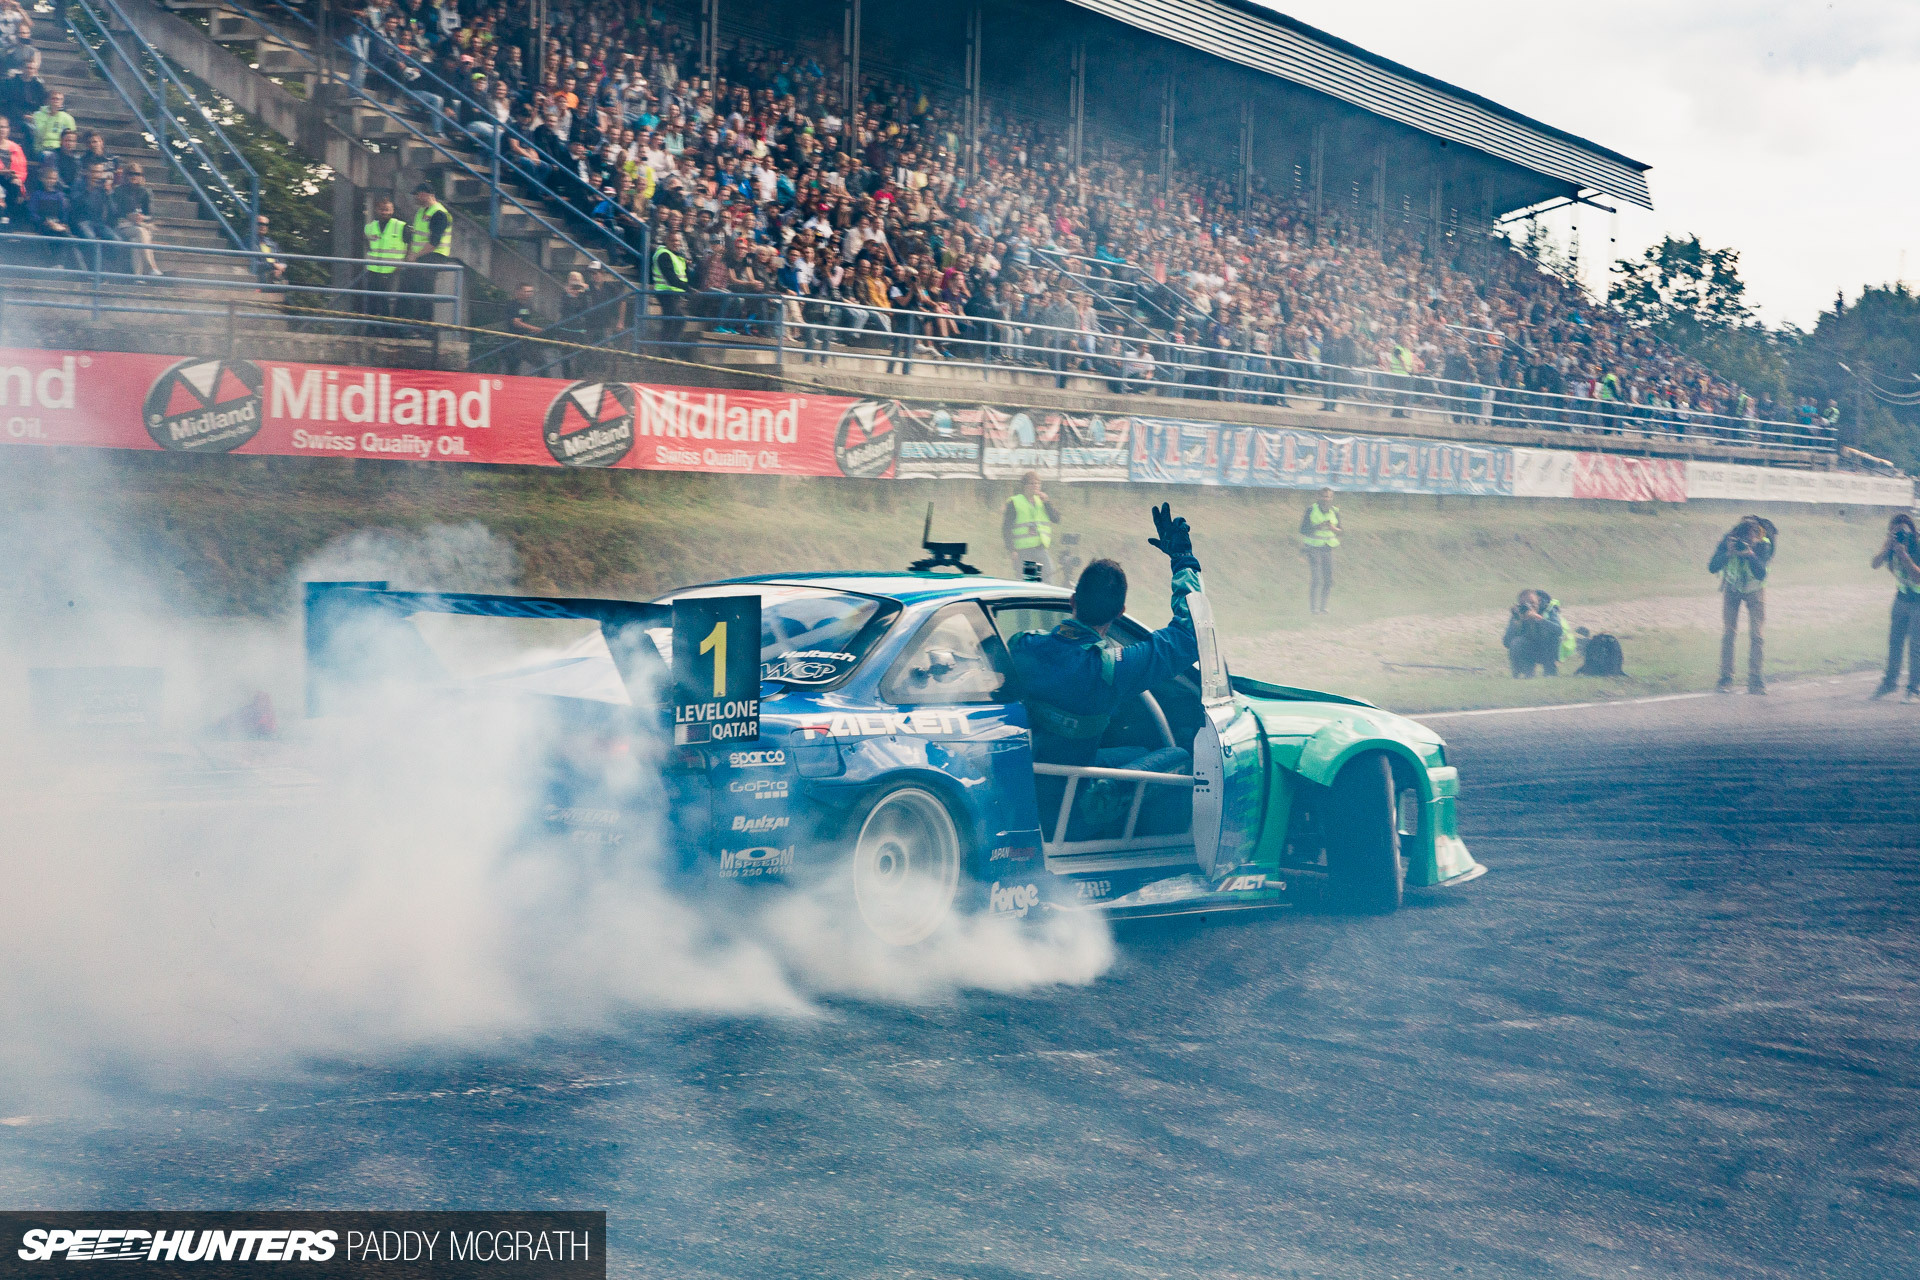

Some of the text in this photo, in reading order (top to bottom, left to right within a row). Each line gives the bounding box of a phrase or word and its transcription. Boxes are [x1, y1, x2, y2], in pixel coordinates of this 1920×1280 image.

[270, 367, 491, 428] Midland
[168, 400, 256, 440] Midland
[640, 390, 799, 443] Midland
[292, 429, 470, 458] Swiss Quality Oil.
[563, 419, 631, 456] Midland
[656, 446, 701, 465] Swiss
[703, 448, 757, 471] Quality
[700, 621, 728, 697] 1
[778, 650, 857, 662] Haltech
[675, 700, 758, 723] LEVELONE
[712, 721, 758, 741] QATAR
[729, 750, 785, 767] sparco
[730, 780, 788, 793] GoPro
